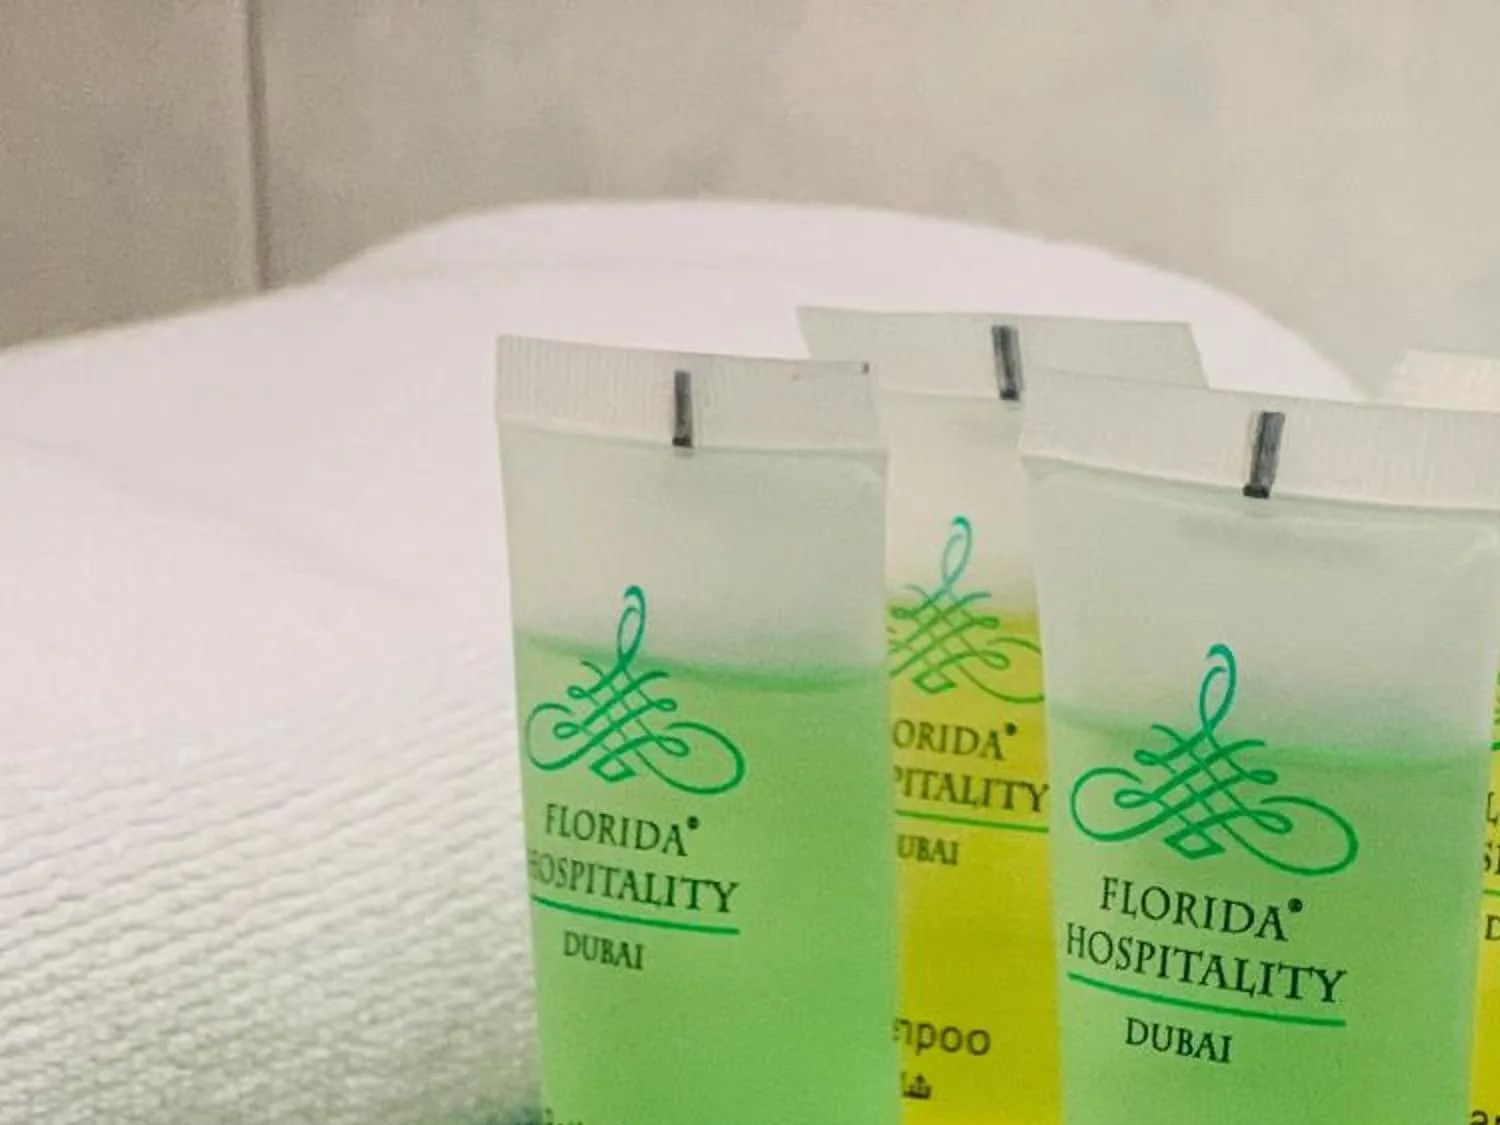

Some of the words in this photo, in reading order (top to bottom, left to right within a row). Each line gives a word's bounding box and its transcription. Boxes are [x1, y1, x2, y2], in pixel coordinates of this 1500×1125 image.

[892, 719, 1004, 761] ORIDA
[897, 833, 960, 866] UBAI
[563, 930, 645, 970] DUBAI
[1066, 922, 1349, 1004] HOSPITALITY
[1124, 1017, 1233, 1064] DUBAI
